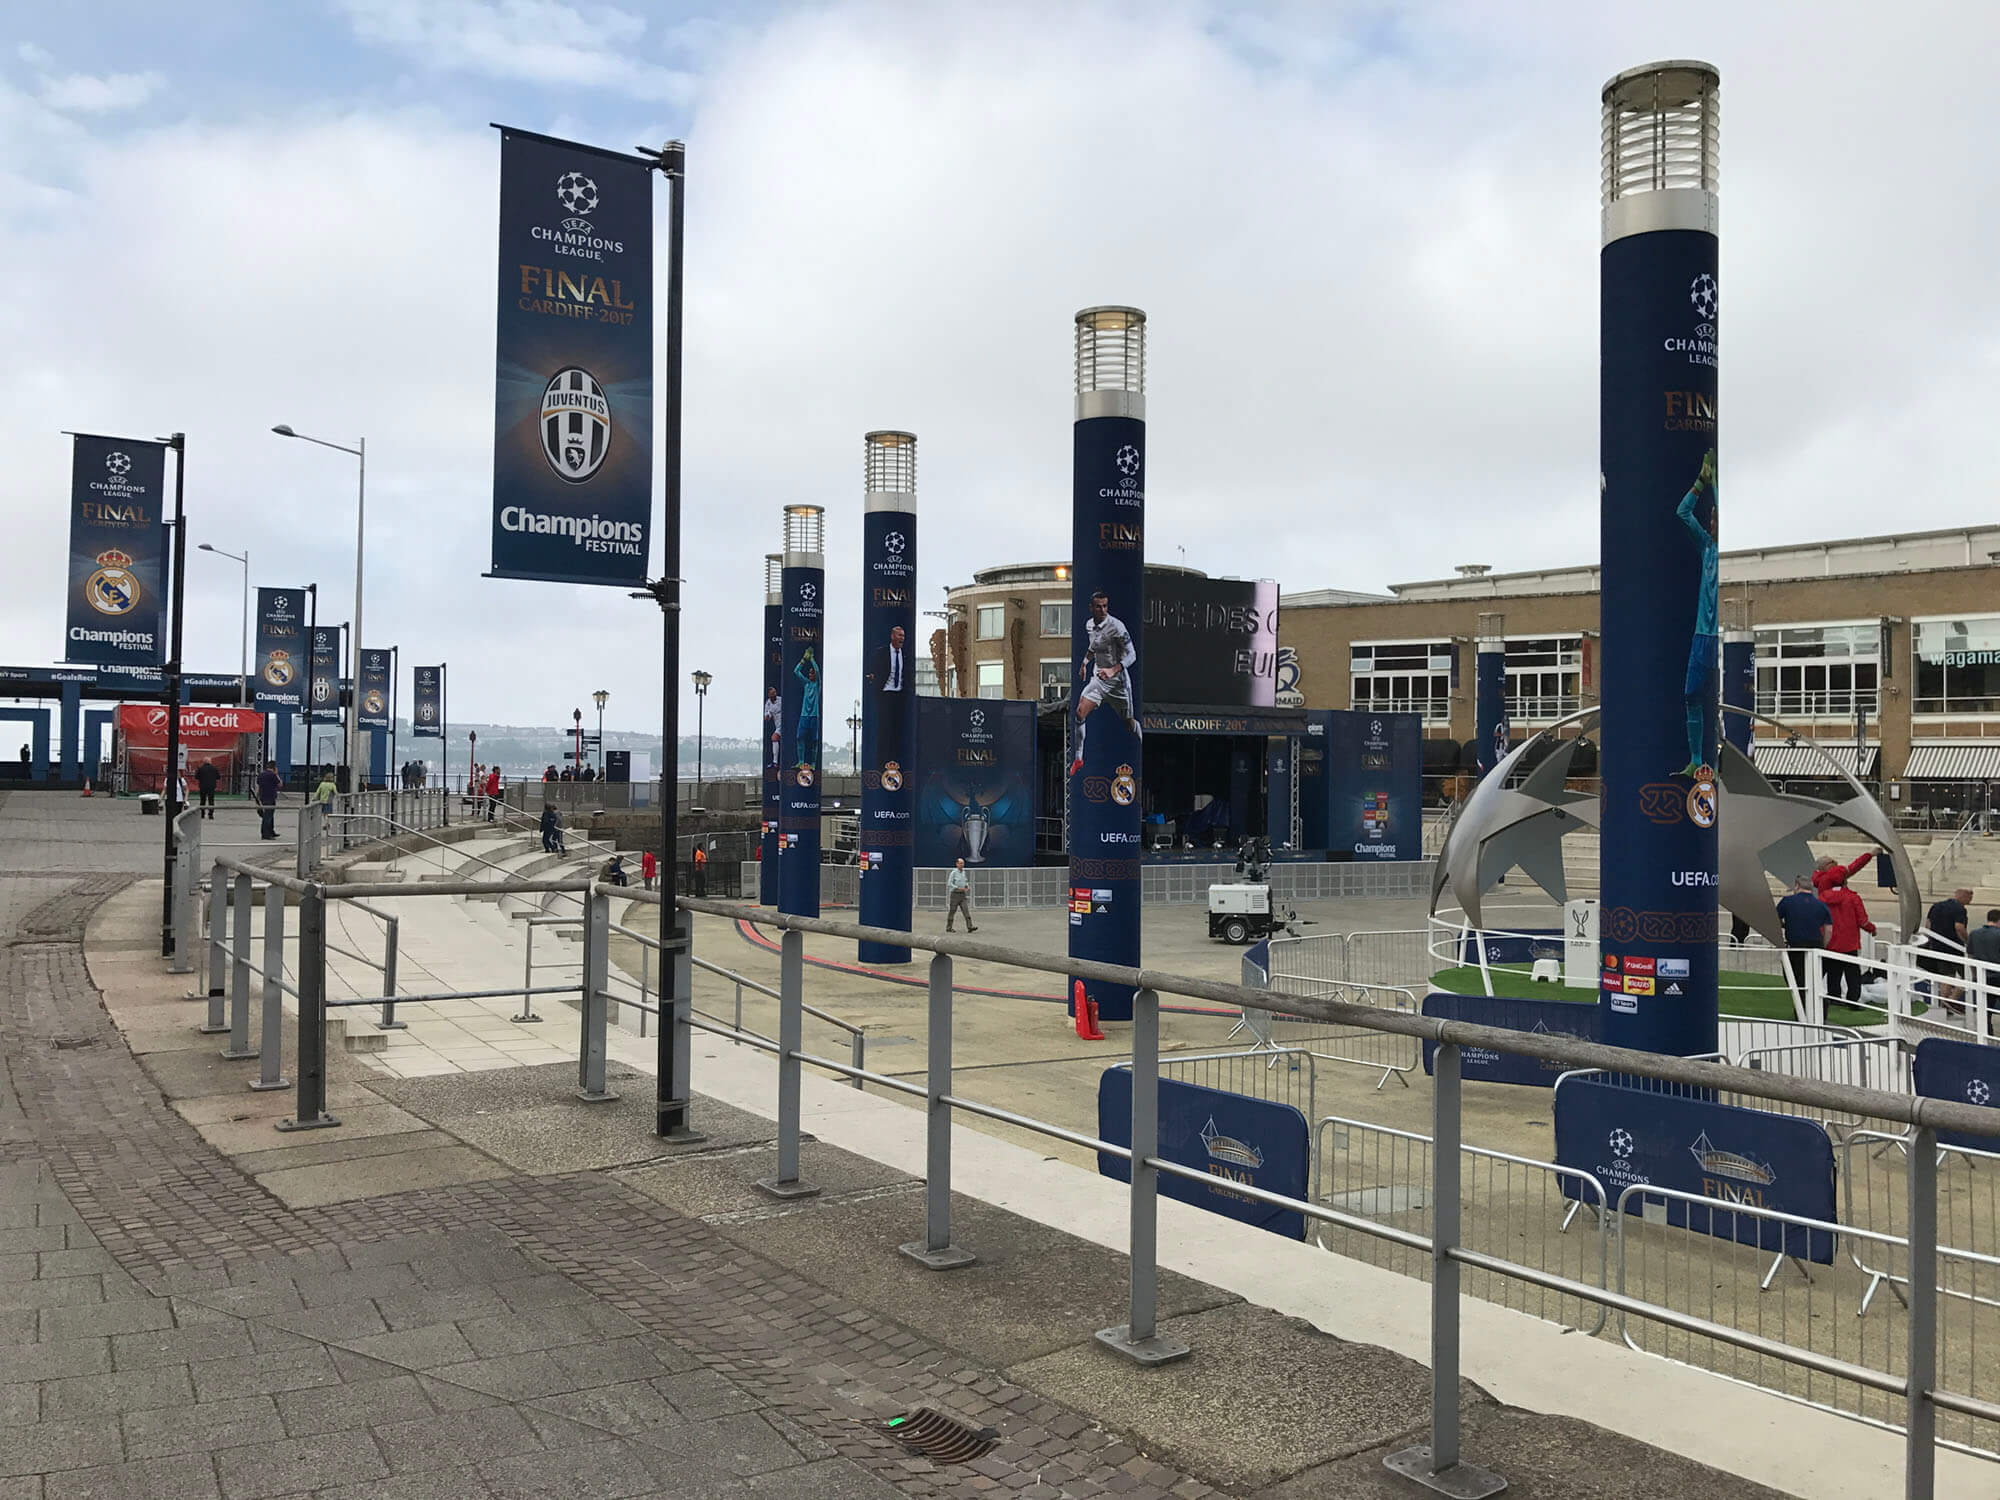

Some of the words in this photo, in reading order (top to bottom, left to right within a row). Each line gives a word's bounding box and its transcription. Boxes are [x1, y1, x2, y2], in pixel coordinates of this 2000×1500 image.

[561, 219, 592, 234] UEFA
[531, 226, 624, 253] CHAMPIONS
[554, 244, 602, 261] LEAGUE
[519, 264, 634, 310] FINAL
[547, 393, 605, 415] JUVENTUS
[89, 481, 146, 493] CHAMPIONS
[1120, 478, 1138, 489] UEFA
[103, 490, 131, 498] LEAGUE
[1115, 499, 1141, 508] LEAGUE
[81, 502, 152, 522] FINAL
[500, 506, 642, 545] Champions
[585, 540, 642, 556] FESTIVAL
[873, 563, 914, 572] CHAMPIONS
[263, 624, 297, 634] FINAL
[70, 627, 153, 646] Champions
[119, 643, 154, 651] FESTIVAL
[256, 692, 300, 703] Champions
[180, 712, 239, 728] niCredit
[1175, 719, 1221, 730] CARDIFF
[1225, 720, 1247, 730] 2017
[957, 749, 997, 761] FINAL
[1354, 843, 1396, 856] Champions
[1461, 1052, 1499, 1060] HAMPIONS
[1613, 1159, 1632, 1170] UEFA
[1596, 1165, 1650, 1184] CHAMPIONS
